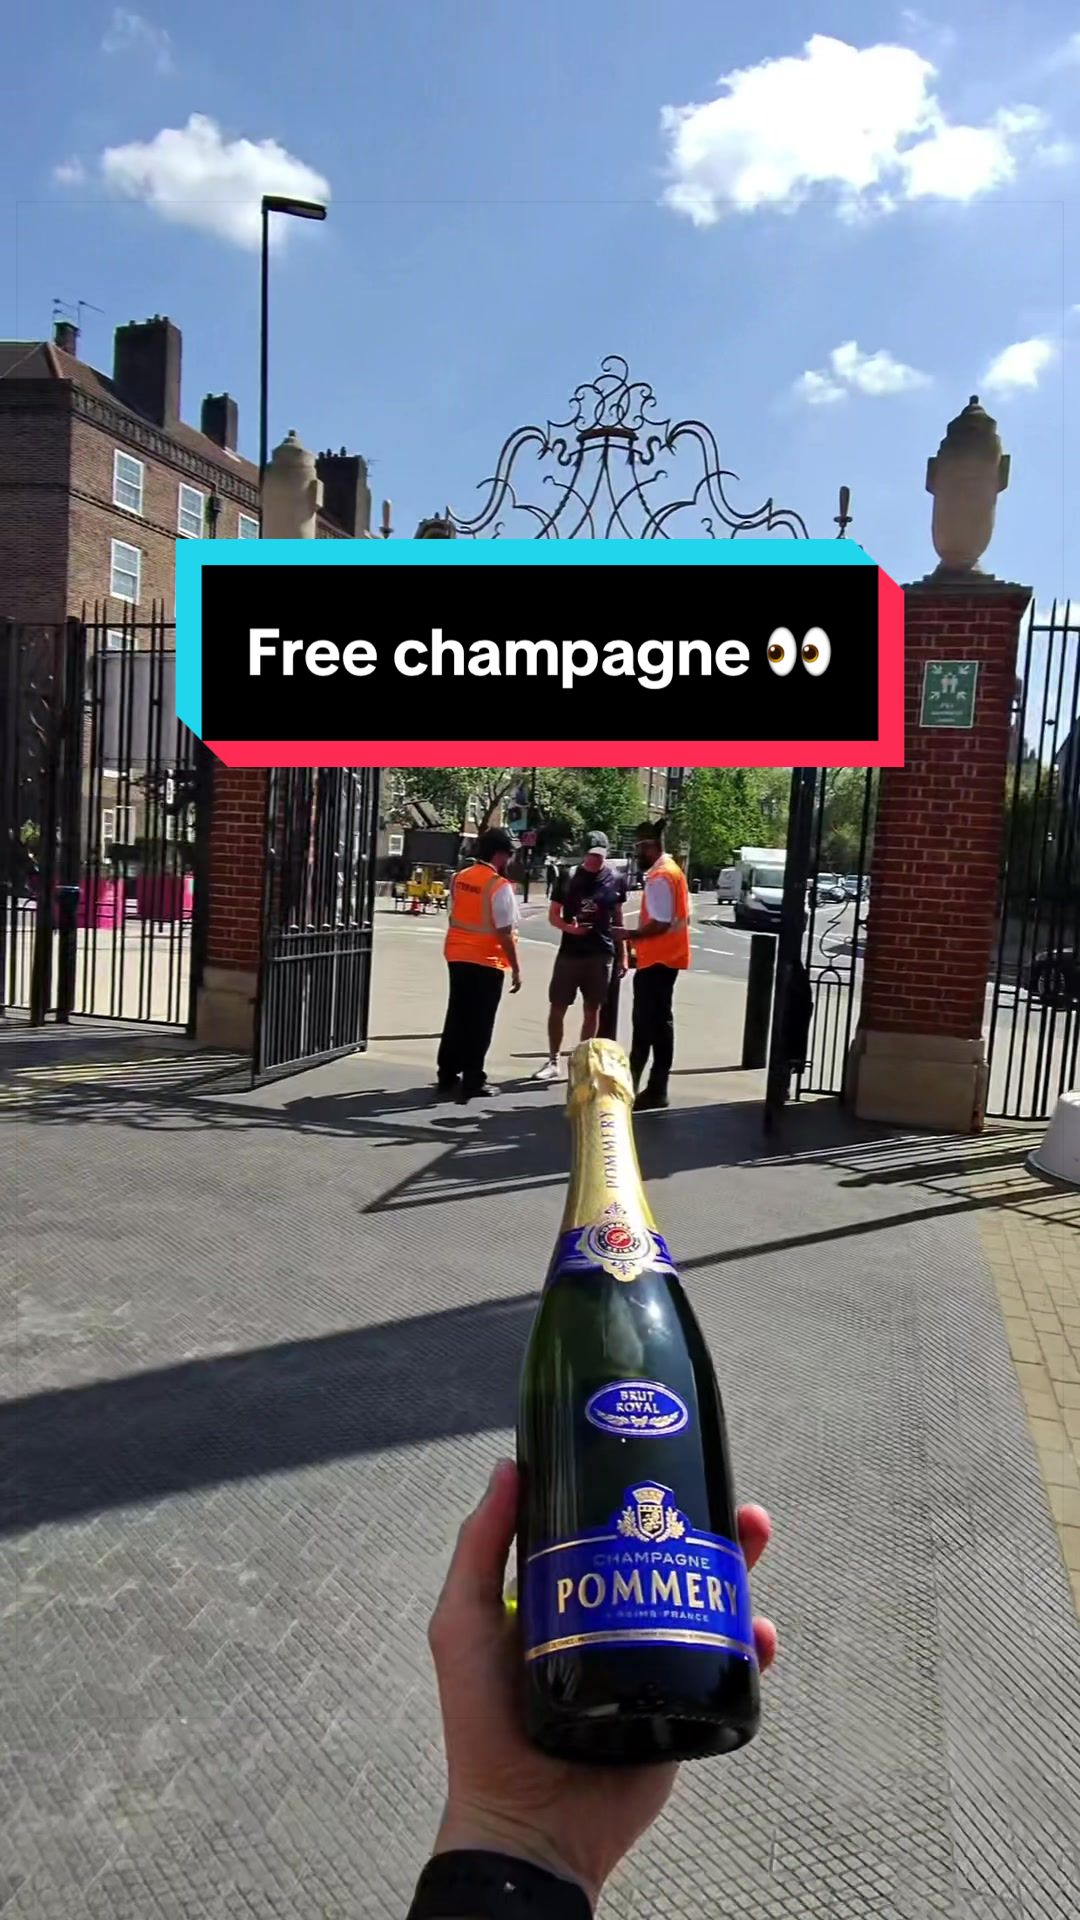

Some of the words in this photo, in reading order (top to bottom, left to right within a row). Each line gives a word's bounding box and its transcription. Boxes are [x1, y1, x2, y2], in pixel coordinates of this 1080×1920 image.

[600, 1111, 619, 1189] POMMERY
[620, 1390, 655, 1402] BRUT
[616, 1402, 660, 1414] ROYAL
[593, 1551, 711, 1570] CHAMPAGNE
[556, 1569, 738, 1617] POMMERY
